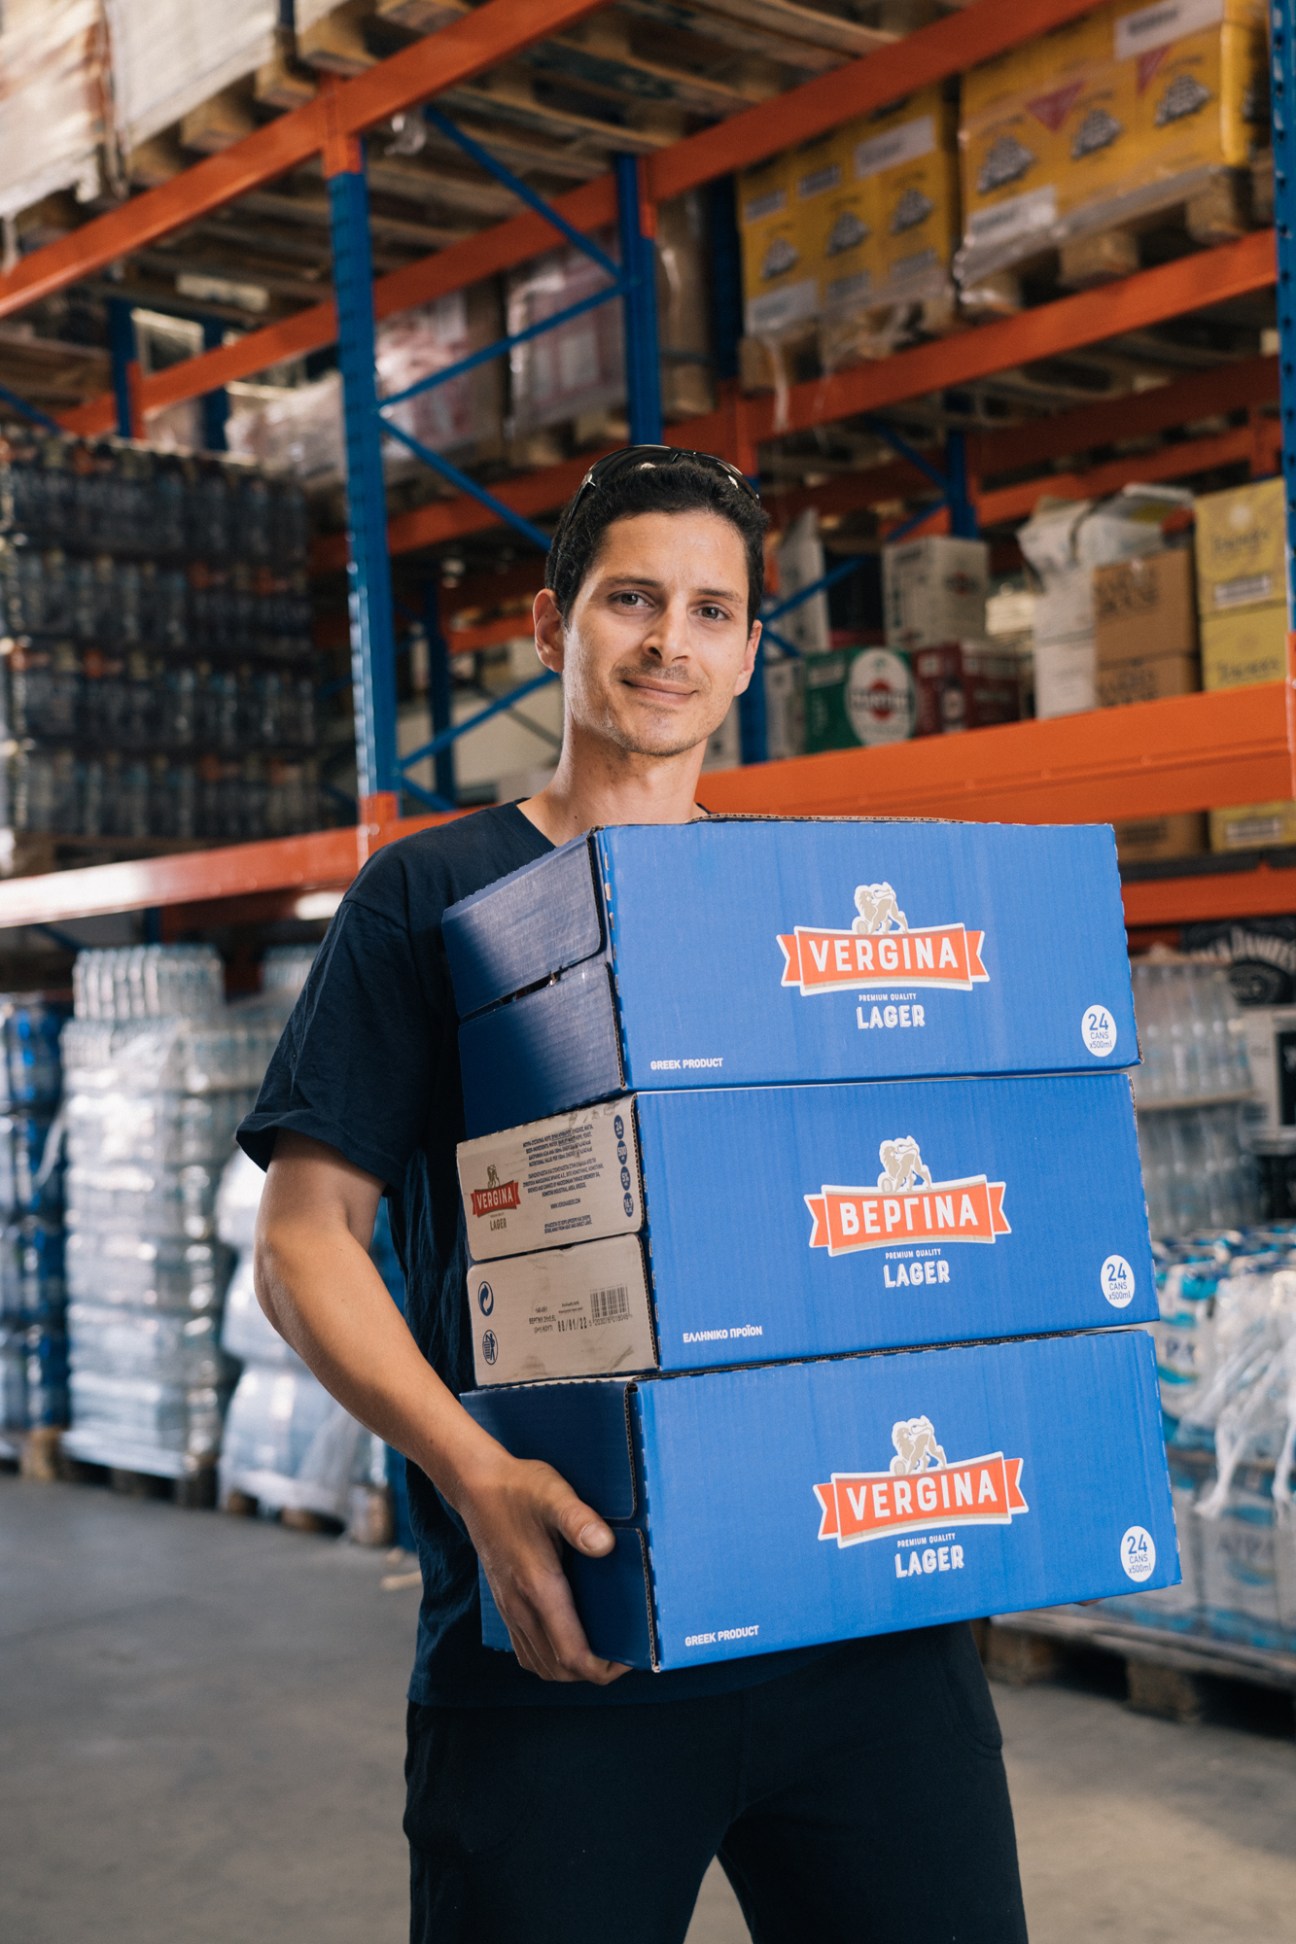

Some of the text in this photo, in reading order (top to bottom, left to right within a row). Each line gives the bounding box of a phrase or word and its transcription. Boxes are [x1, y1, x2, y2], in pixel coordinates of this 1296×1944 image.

[808, 937, 959, 972] VERGINA
[858, 992, 917, 1002] PREMIUM QUALITY
[856, 1004, 925, 1030] LAGER
[1088, 1012, 1109, 1031] 24
[1090, 1031, 1109, 1040] CANS
[1090, 1040, 1112, 1049] x500ml
[650, 1057, 724, 1071] GREEK PRODUCT
[476, 1186, 514, 1210] VERGINA
[490, 1217, 507, 1231] LAGER
[885, 1248, 941, 1259] PREMIUM QUALITY
[883, 1260, 951, 1288] LAGER
[1107, 1263, 1127, 1281] 24
[1109, 1281, 1128, 1291] CANS
[1109, 1291, 1131, 1300] x500ml
[846, 1469, 998, 1521] VERGINA
[897, 1532, 956, 1548] PREMIUM QUALITY
[1127, 1534, 1147, 1554] 24
[894, 1544, 964, 1579] LAGER
[1129, 1554, 1148, 1564] CANS
[685, 1625, 760, 1647] GREEK PRODUCT
